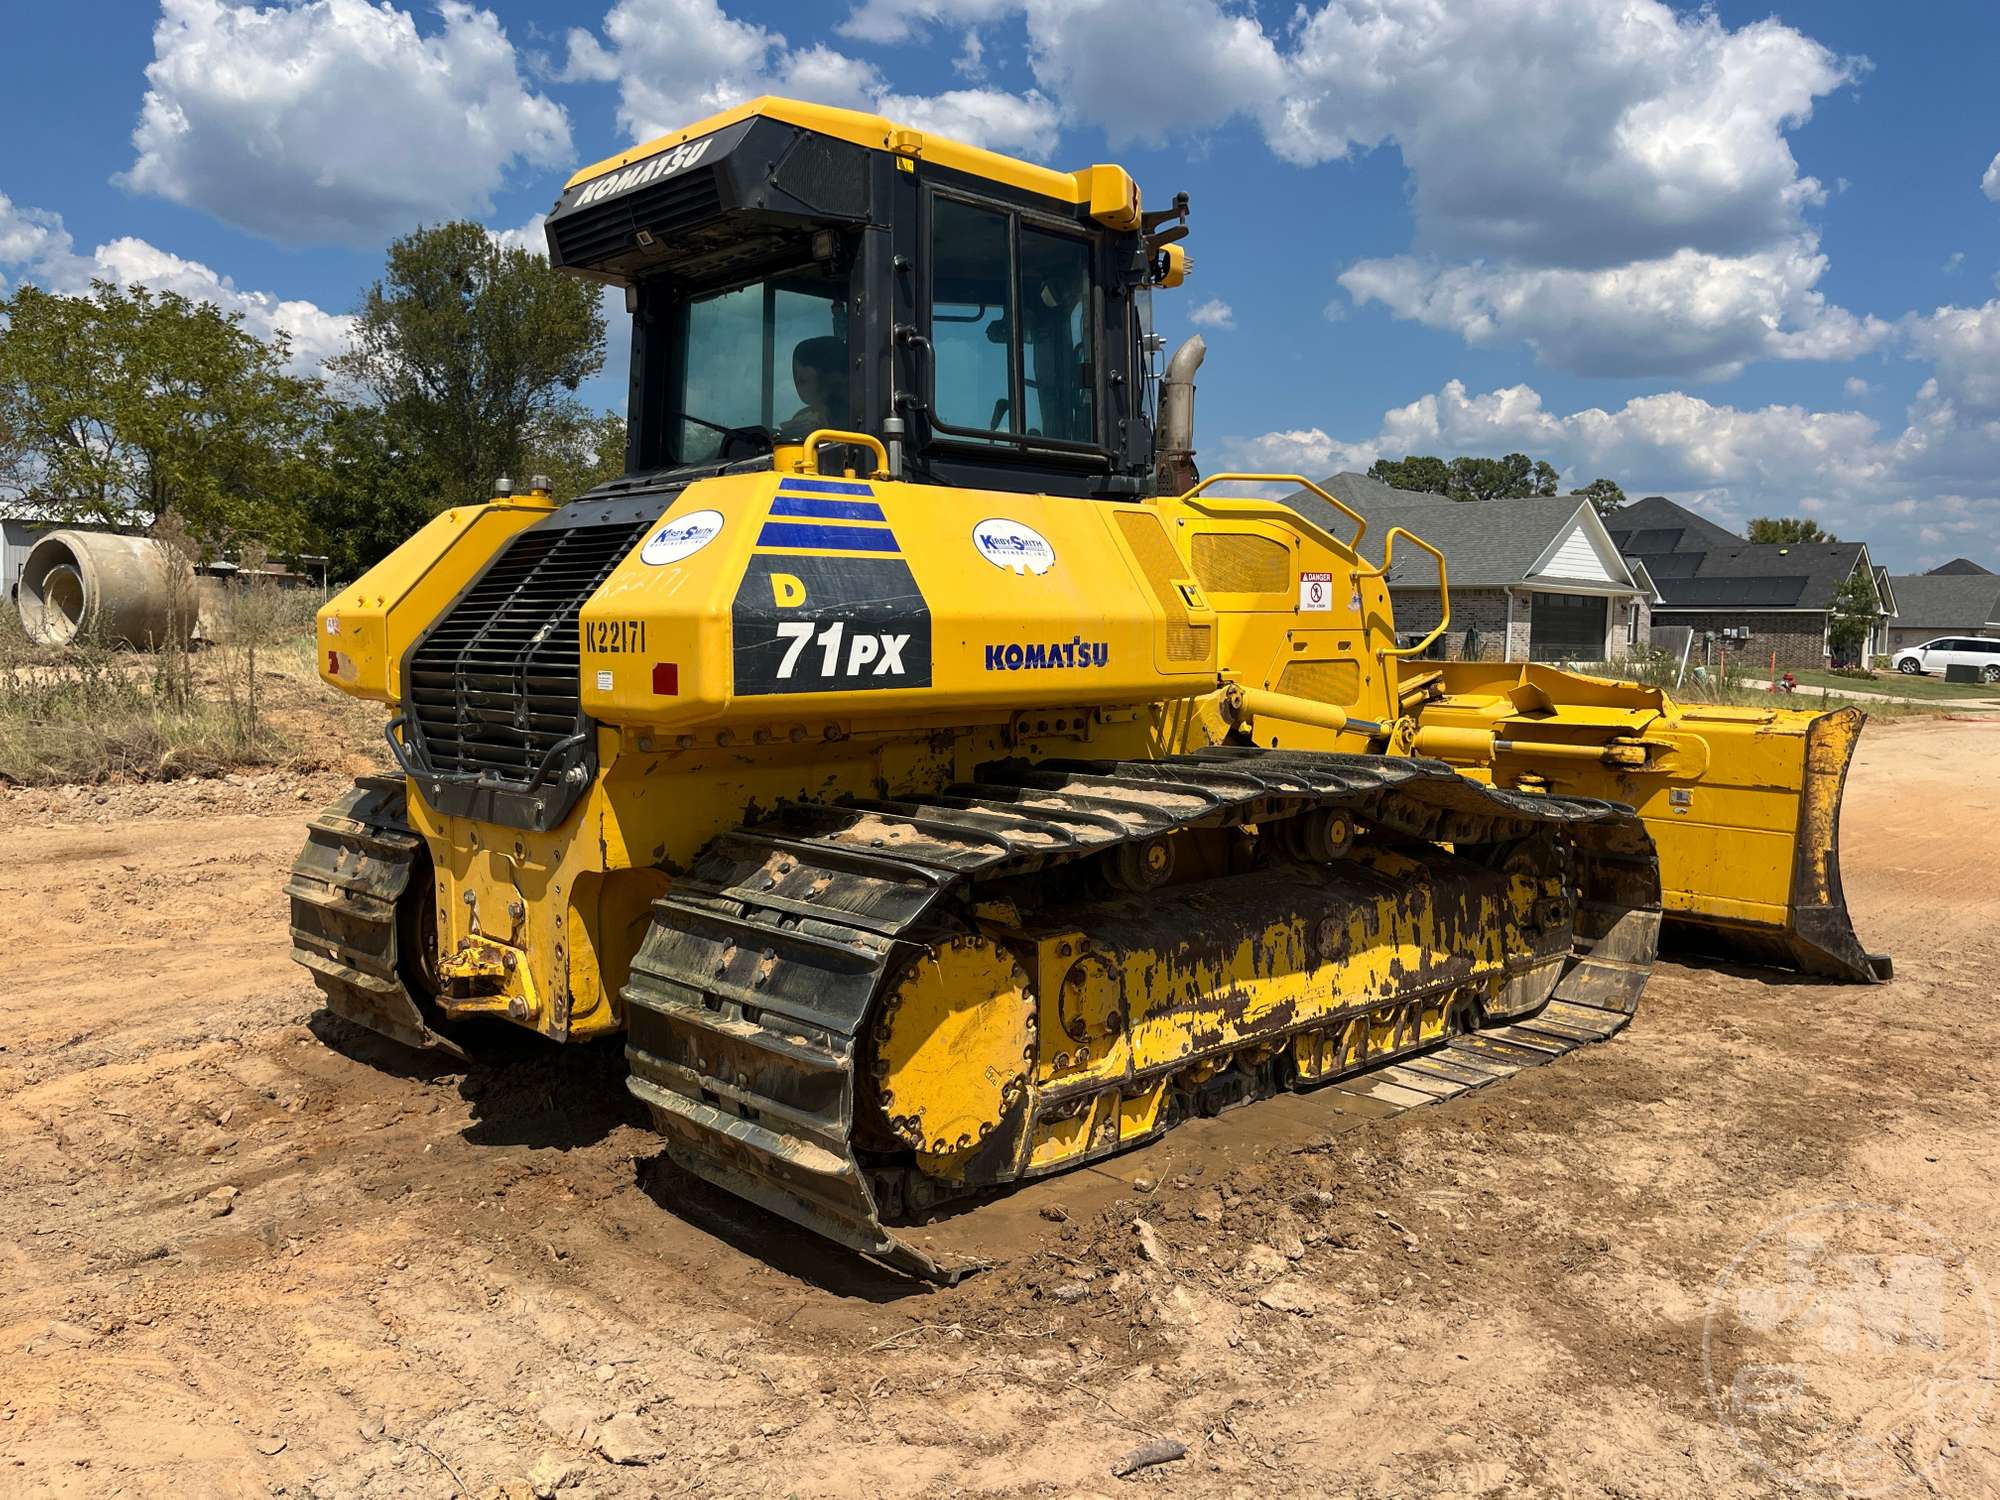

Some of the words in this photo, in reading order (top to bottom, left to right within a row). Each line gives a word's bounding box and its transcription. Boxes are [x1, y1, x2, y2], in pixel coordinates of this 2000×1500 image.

[573, 138, 713, 208] KOMATSU
[769, 572, 807, 608] D
[1308, 573, 1331, 581] DANGER
[586, 620, 645, 653] K22171
[985, 635, 1108, 671] KOMATSU
